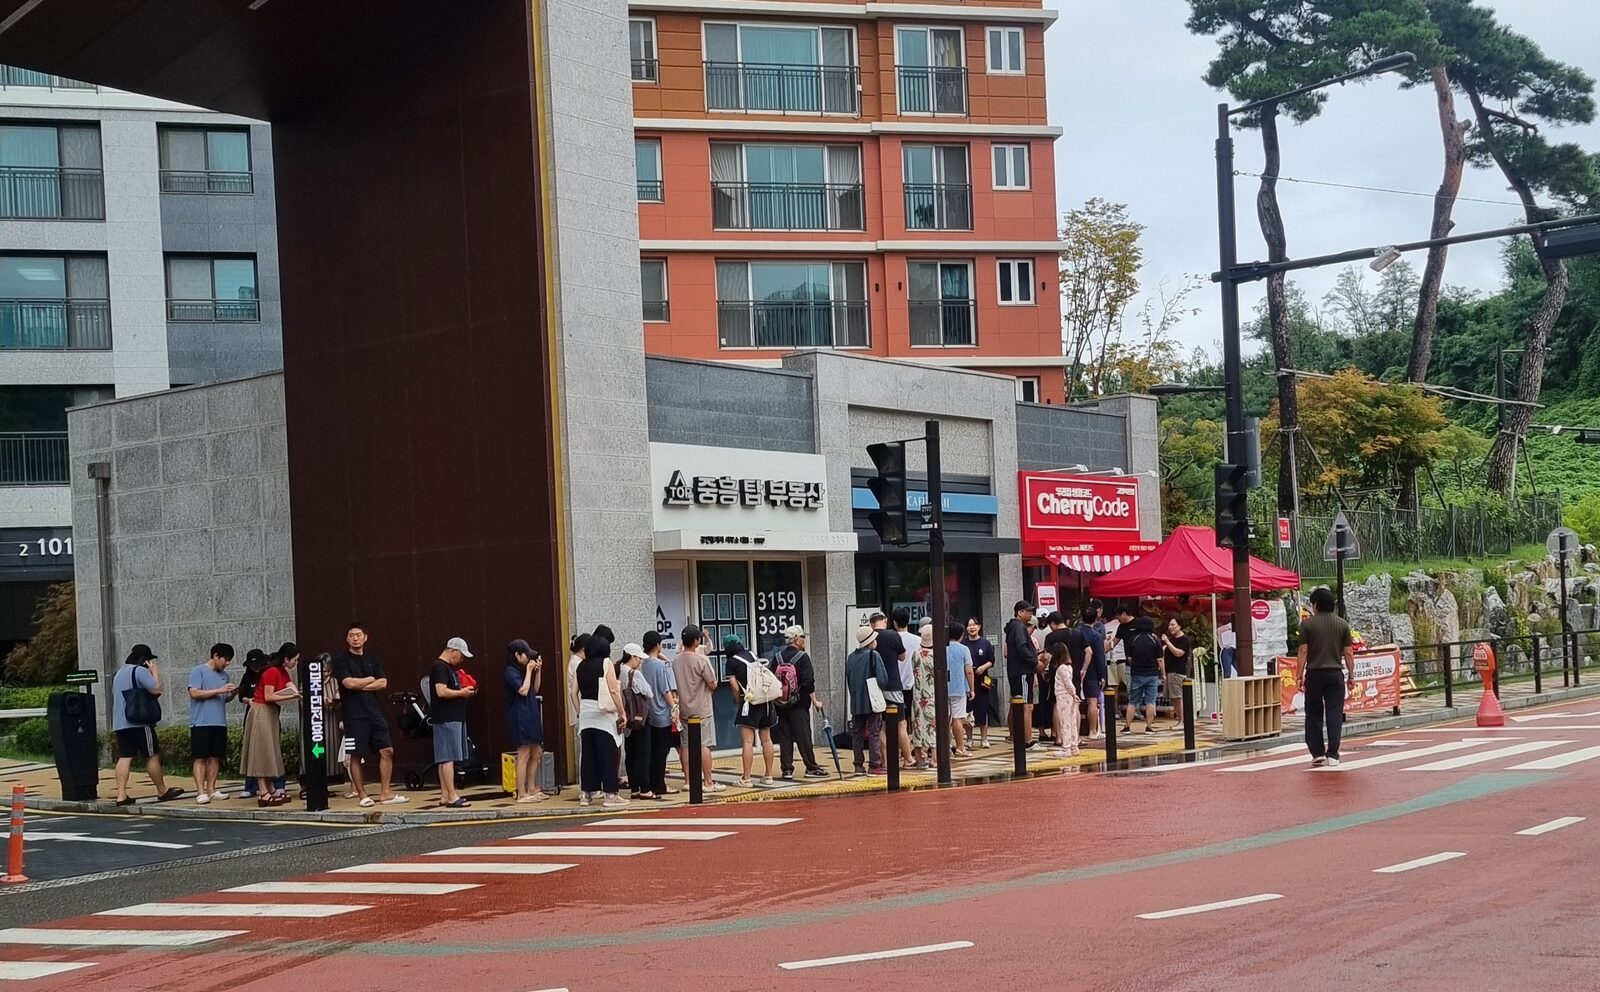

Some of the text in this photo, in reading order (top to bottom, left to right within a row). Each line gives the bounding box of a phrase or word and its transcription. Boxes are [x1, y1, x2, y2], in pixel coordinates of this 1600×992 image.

[668, 486, 693, 499] TOP
[767, 480, 825, 508] 부동산
[1037, 493, 1130, 522] CherryCode
[19, 537, 73, 556] 2 101
[757, 591, 797, 610] 3159
[895, 605, 925, 620] EN
[656, 620, 672, 633] OP
